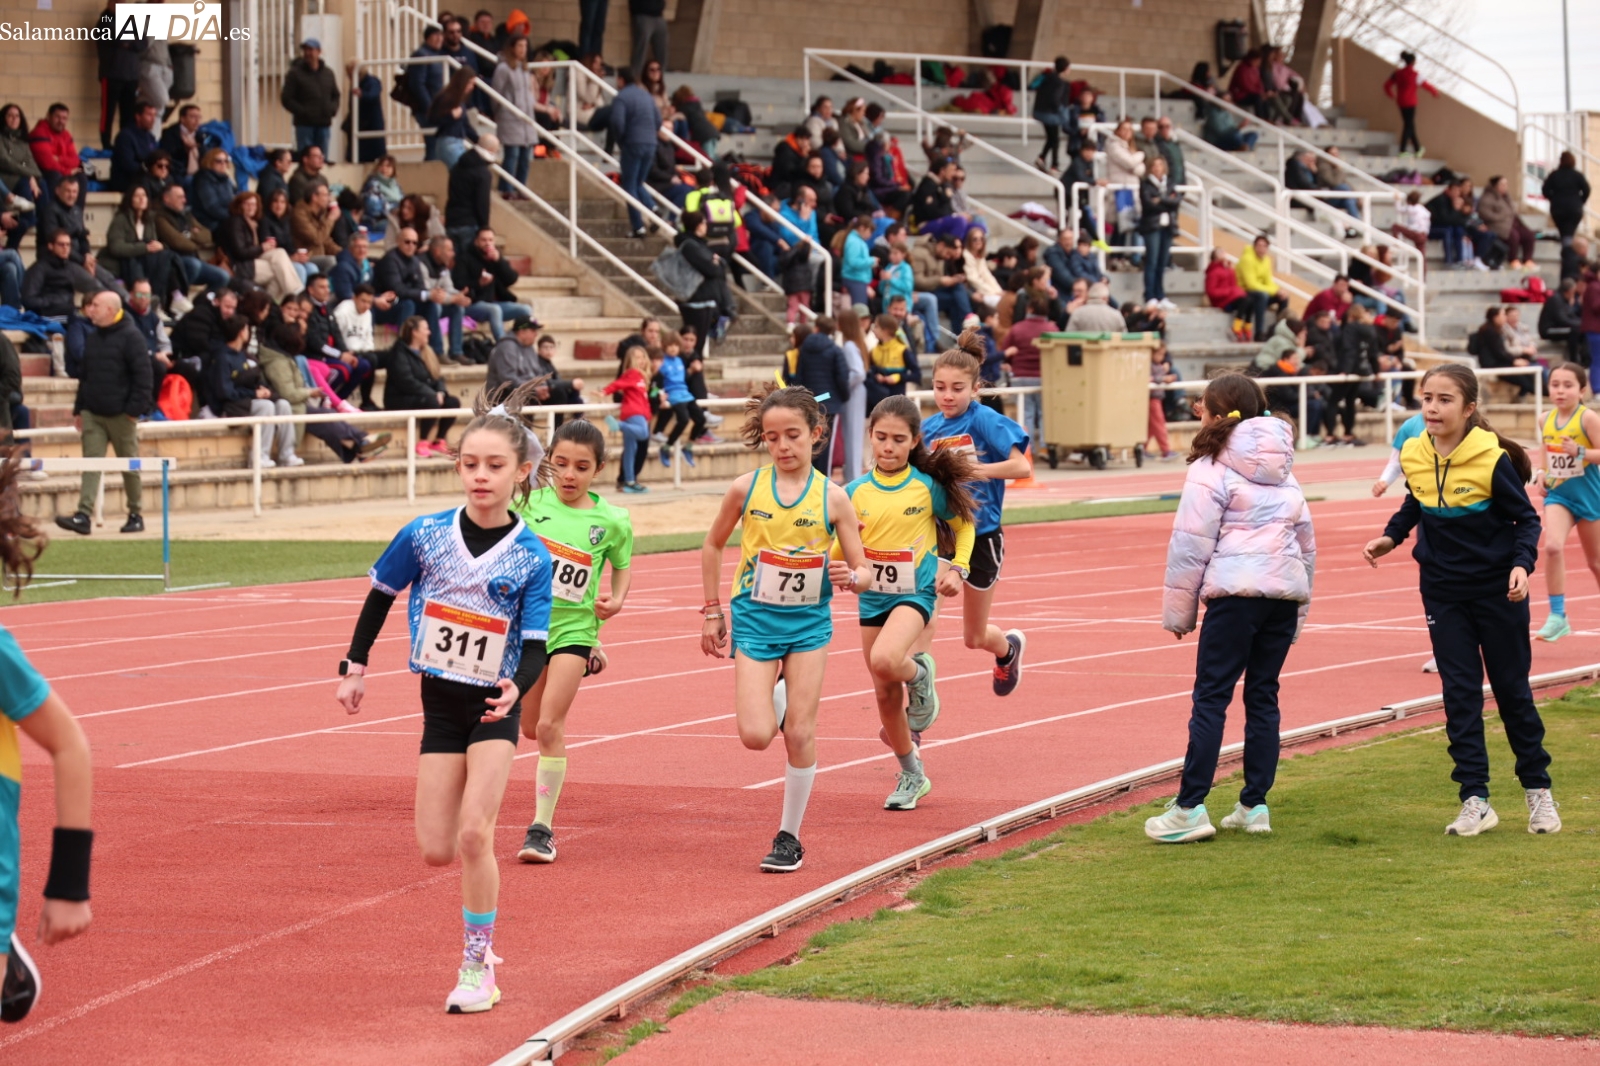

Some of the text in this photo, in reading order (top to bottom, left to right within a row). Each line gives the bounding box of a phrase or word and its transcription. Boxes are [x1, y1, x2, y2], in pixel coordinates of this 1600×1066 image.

[1551, 455, 1576, 469] 202
[551, 559, 588, 588] 180
[778, 571, 806, 592] 73
[872, 563, 898, 584] 79
[435, 626, 489, 661] 311
